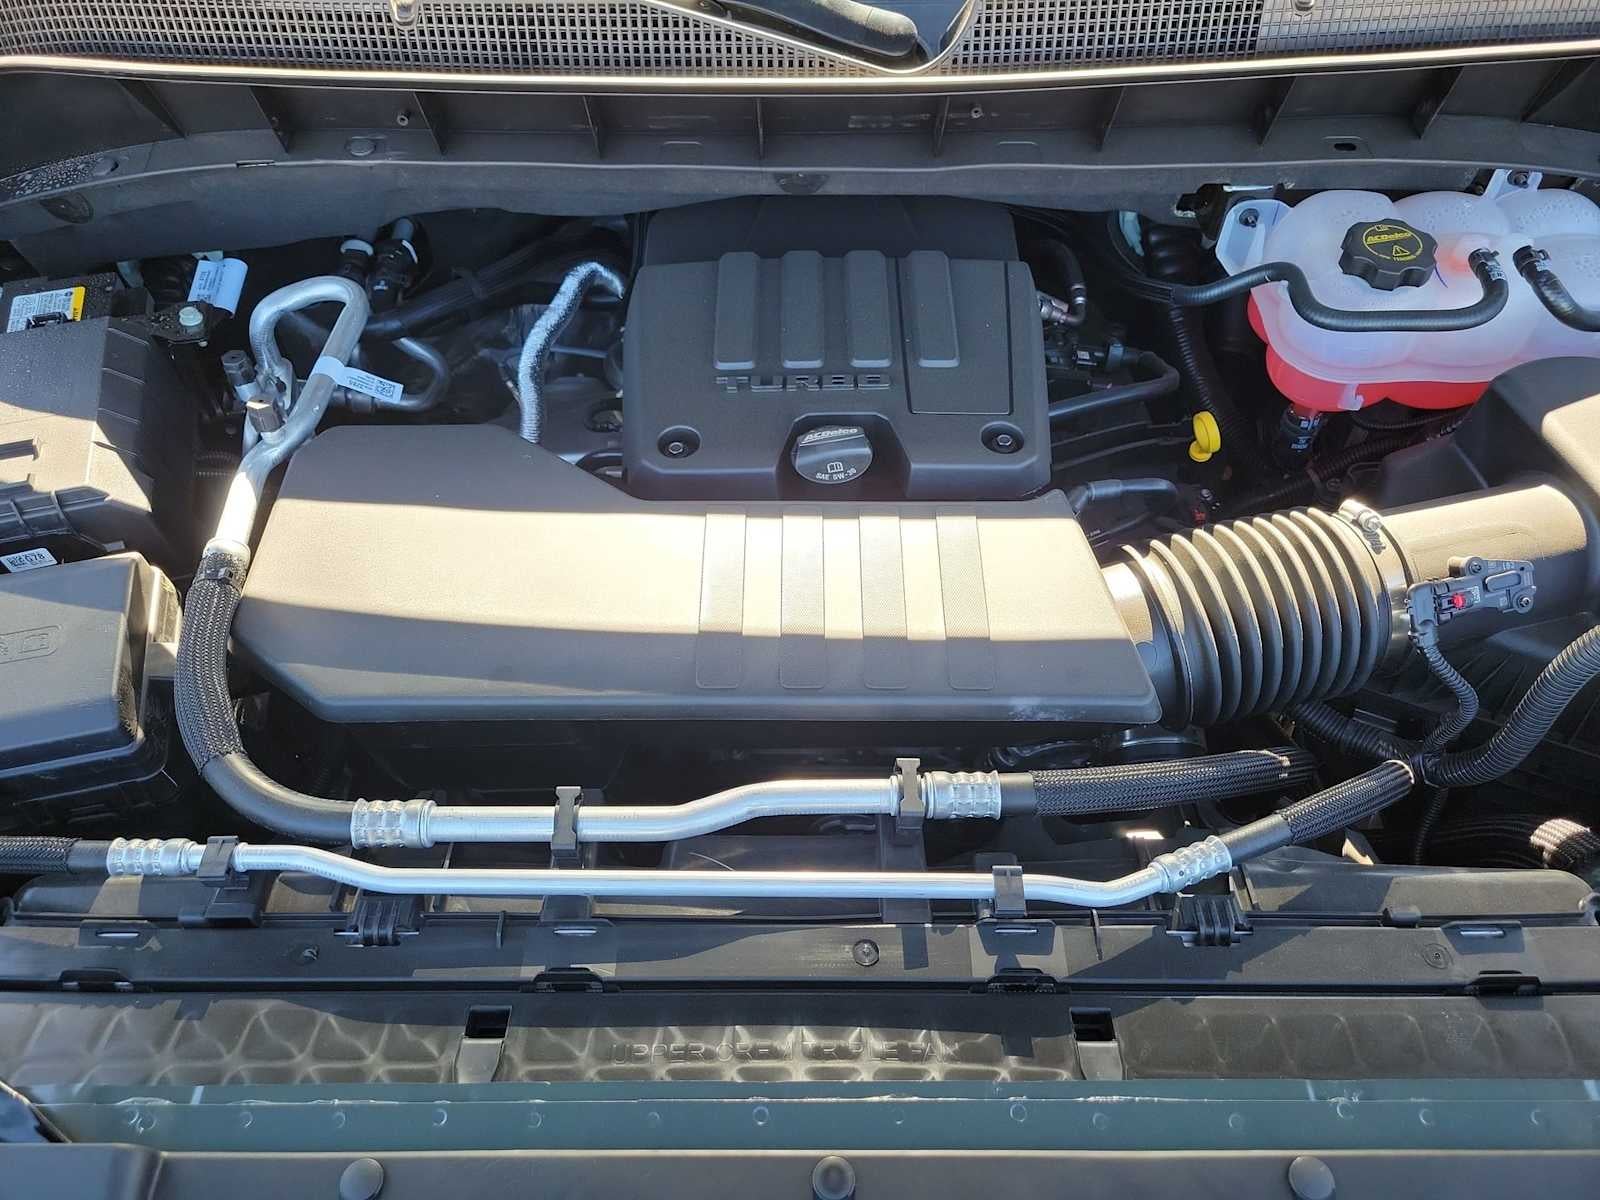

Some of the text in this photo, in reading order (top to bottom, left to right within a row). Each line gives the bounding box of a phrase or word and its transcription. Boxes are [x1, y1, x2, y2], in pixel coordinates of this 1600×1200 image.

[1366, 232, 1412, 243] ACDelco
[715, 374, 891, 393] TURBO
[803, 428, 859, 443] ACDelco
[815, 472, 830, 480] SAE
[801, 1041, 899, 1063] TRPLE
